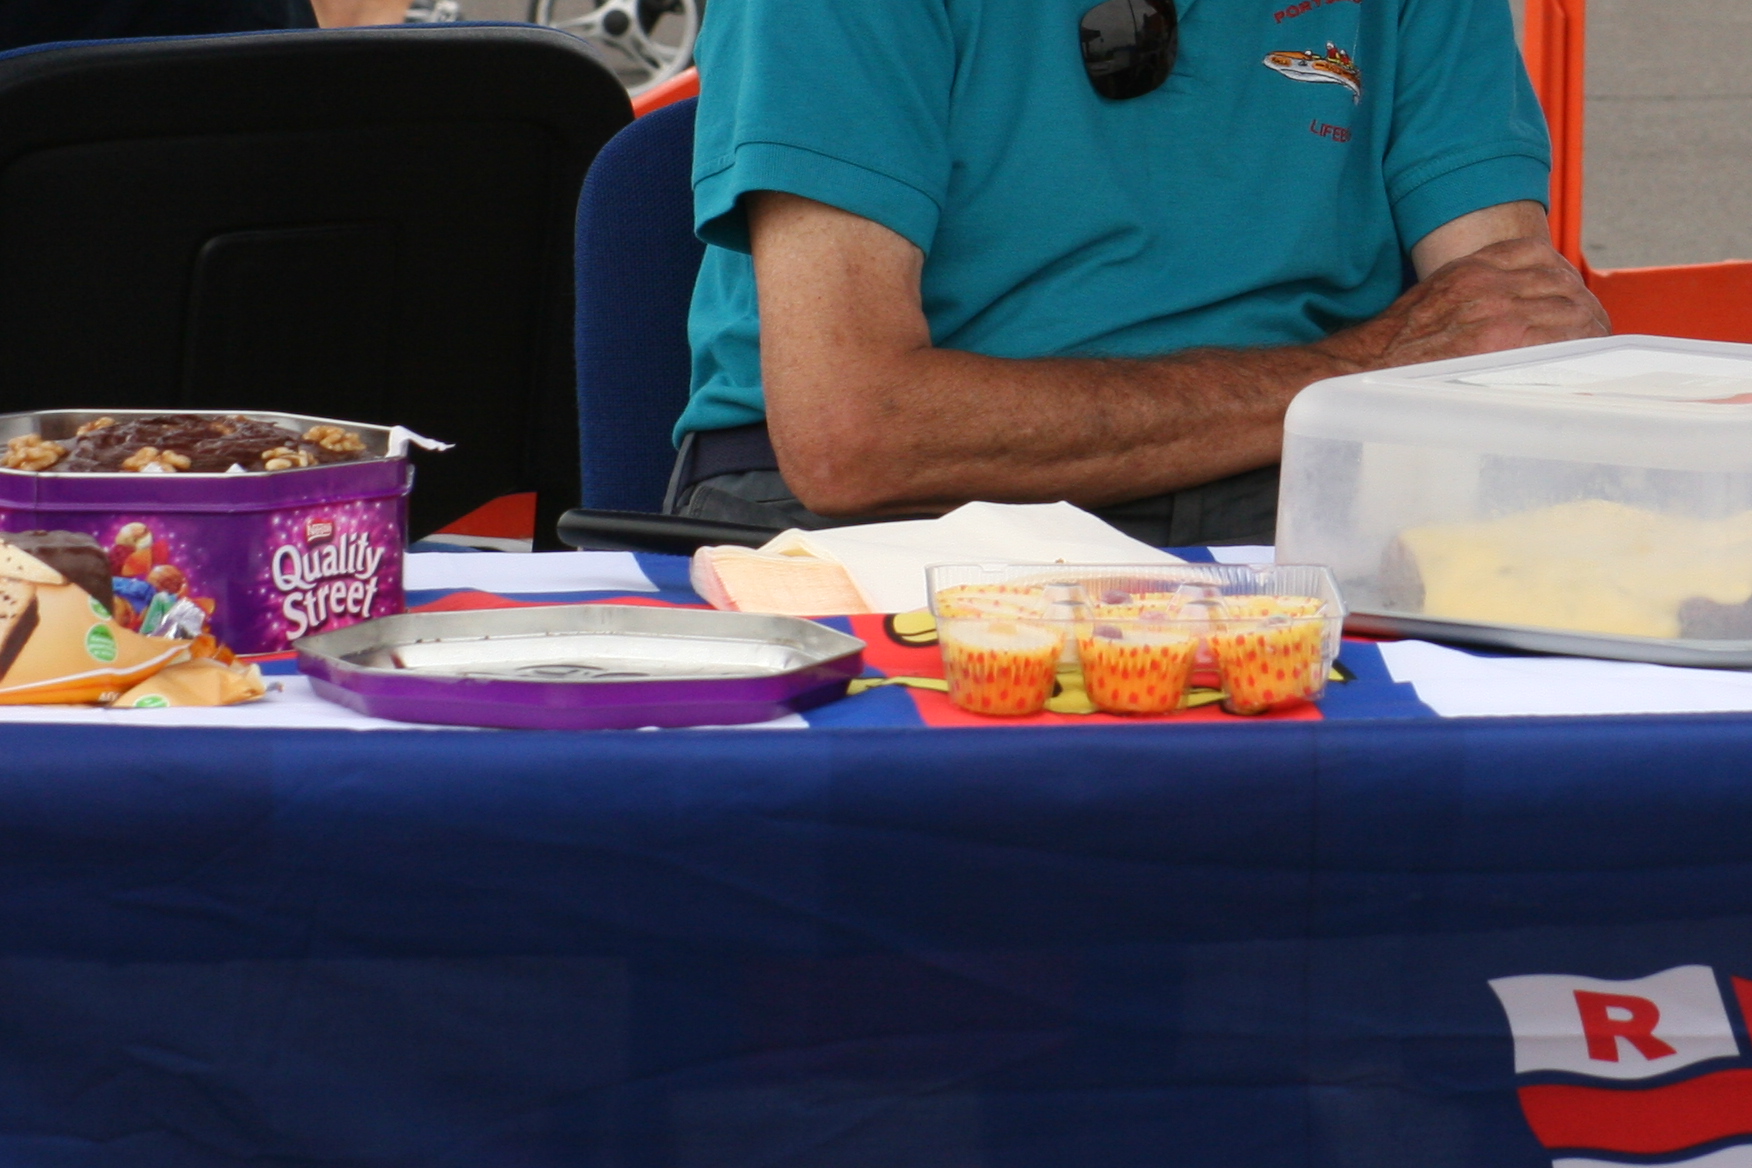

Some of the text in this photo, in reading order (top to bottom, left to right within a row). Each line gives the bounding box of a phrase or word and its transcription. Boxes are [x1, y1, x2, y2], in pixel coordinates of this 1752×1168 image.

[272, 532, 385, 591] Quality
[283, 576, 379, 640] Street
[1573, 989, 1676, 1063] R
